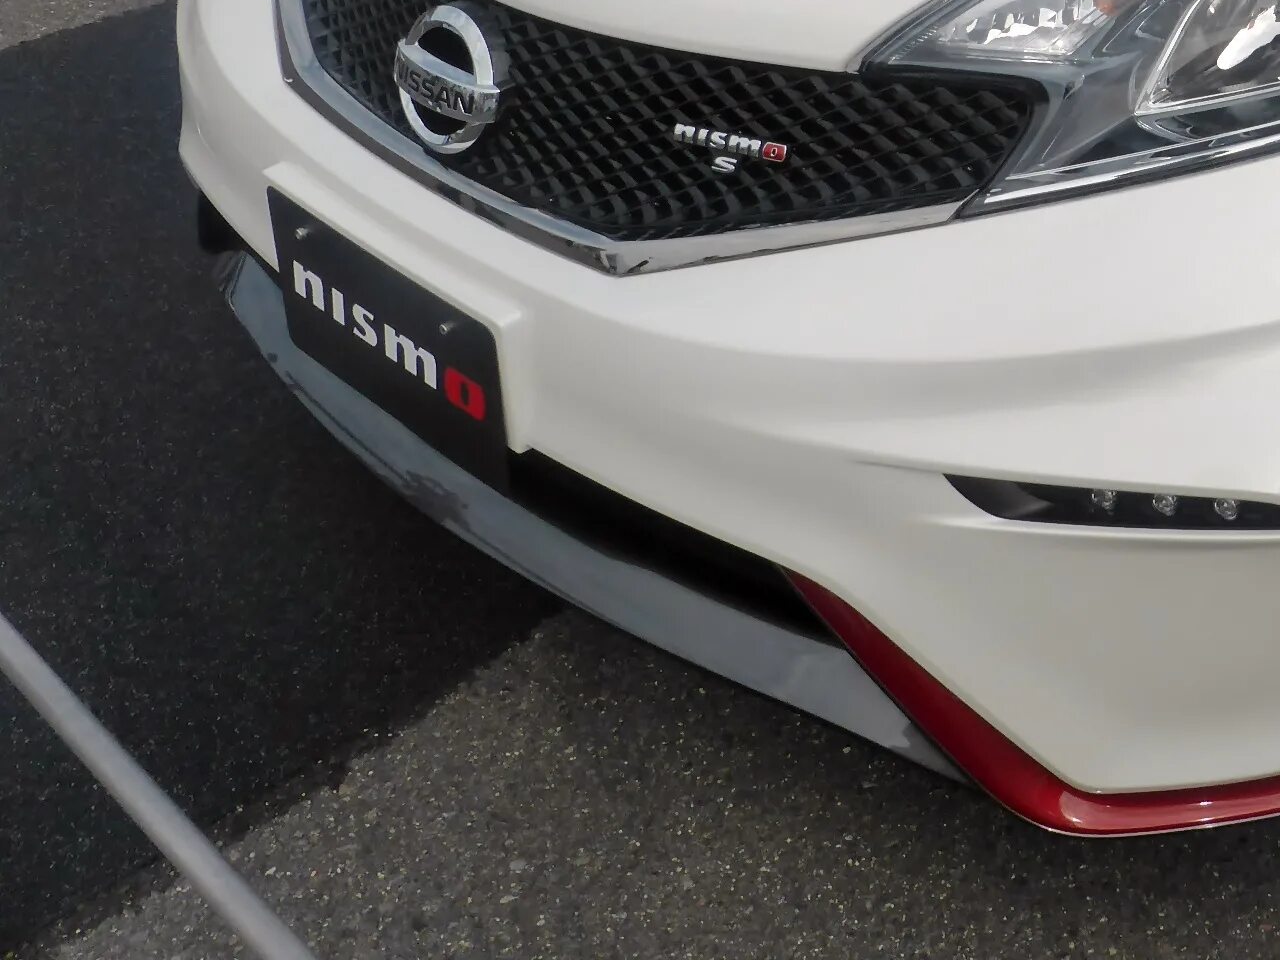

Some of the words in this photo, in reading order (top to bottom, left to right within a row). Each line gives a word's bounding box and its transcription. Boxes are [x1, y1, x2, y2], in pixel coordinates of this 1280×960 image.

[399, 59, 475, 117] NISSAN
[673, 123, 787, 162] nismo
[711, 156, 738, 174] S
[292, 259, 486, 421] nismo
